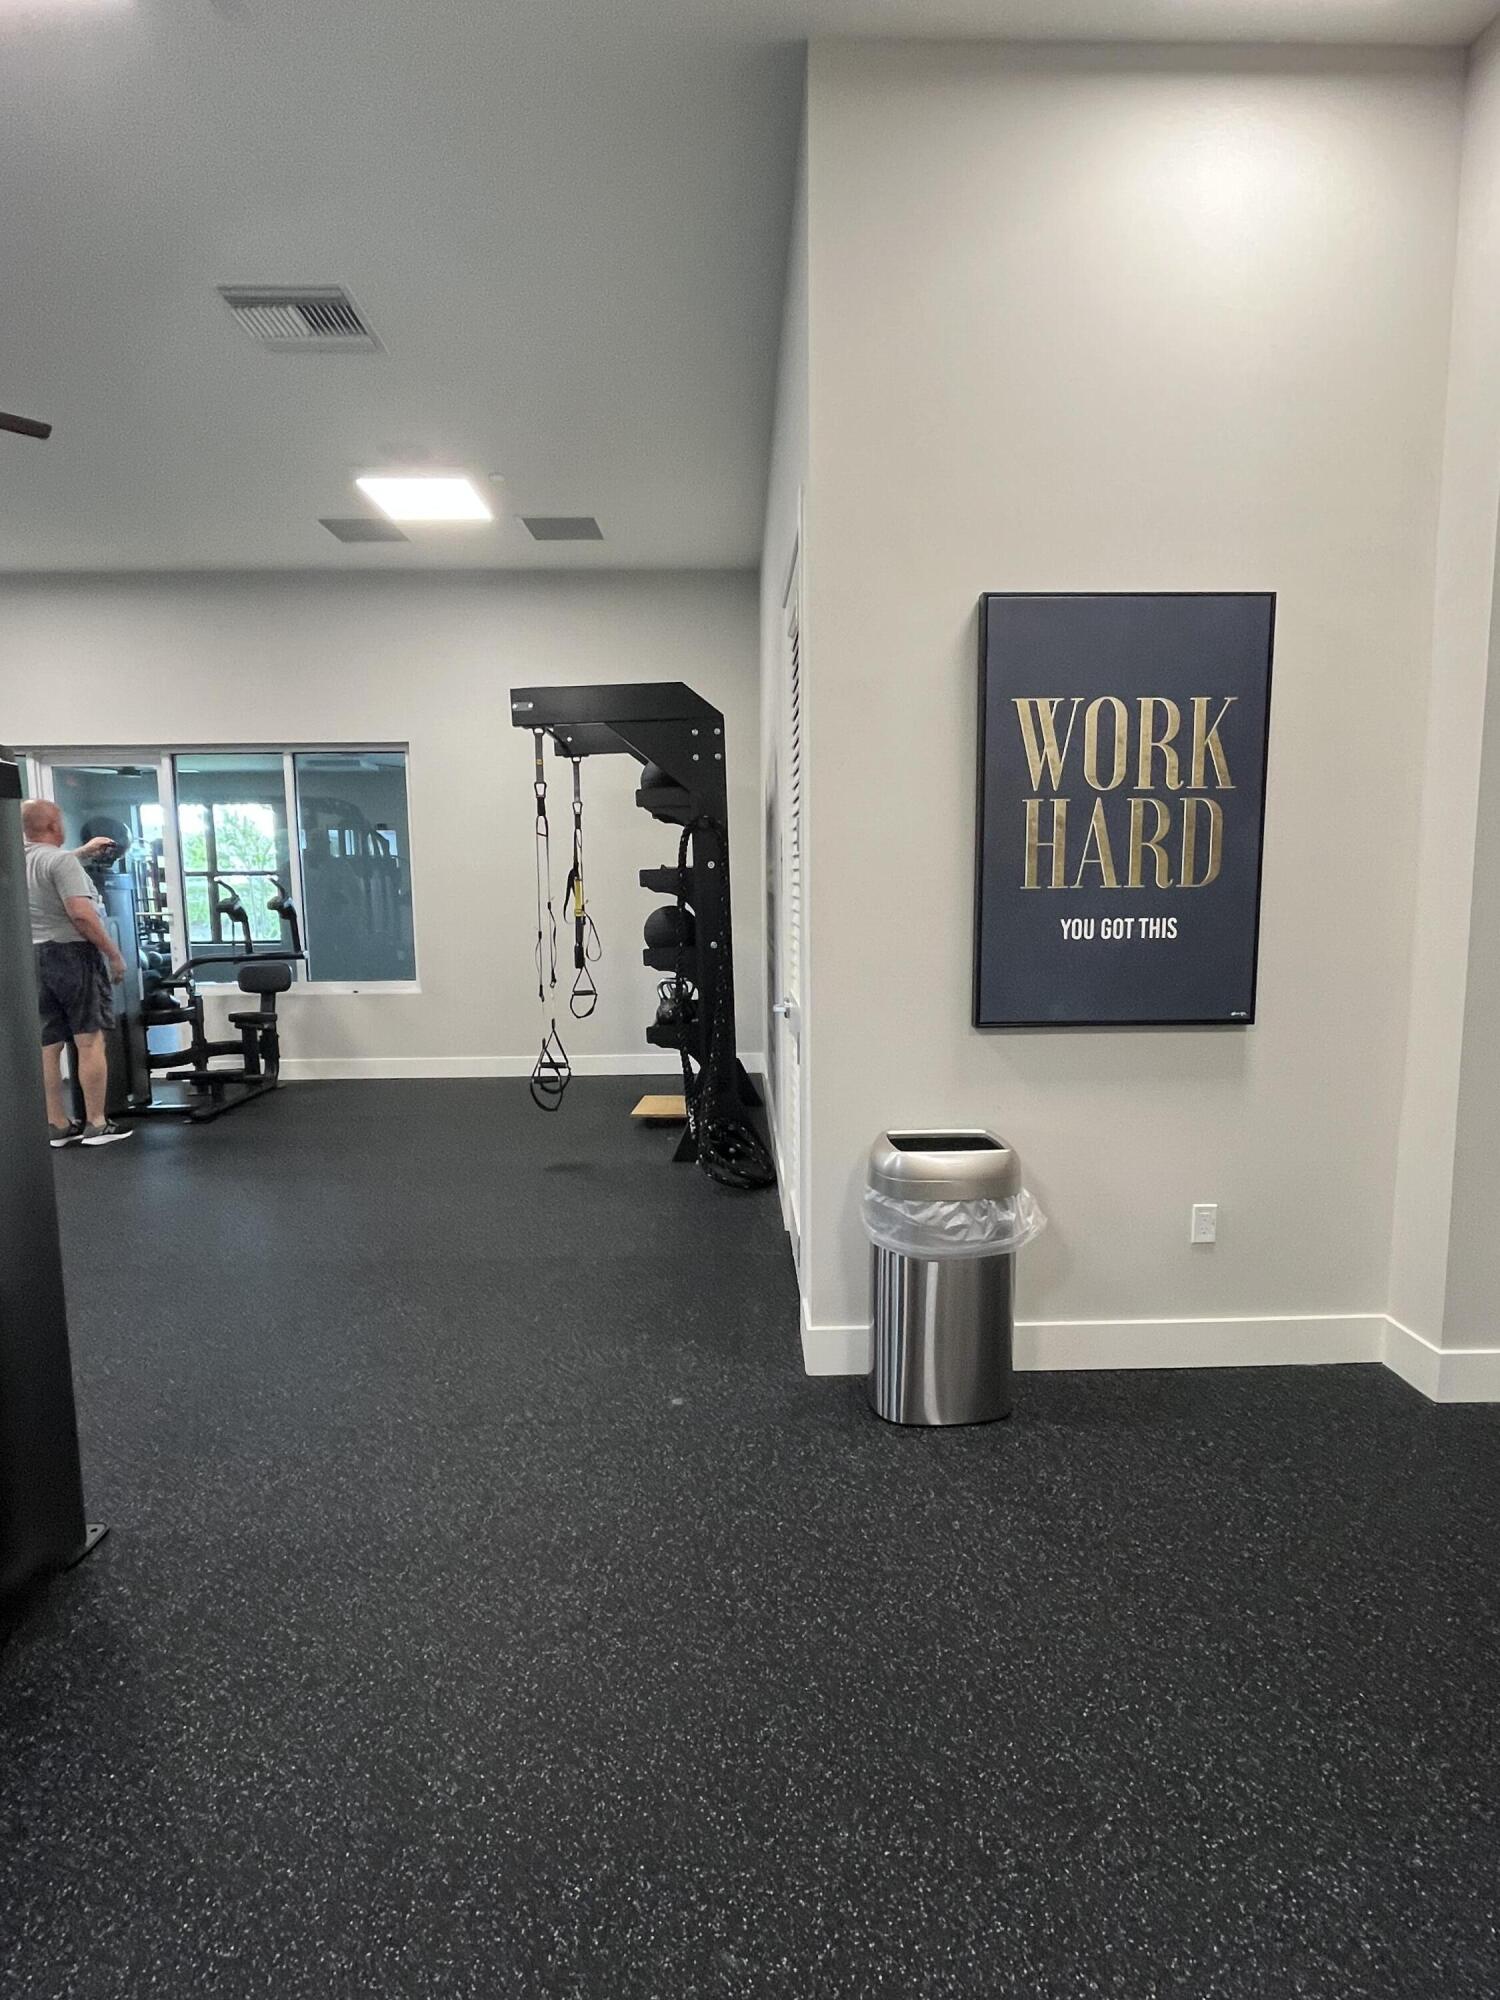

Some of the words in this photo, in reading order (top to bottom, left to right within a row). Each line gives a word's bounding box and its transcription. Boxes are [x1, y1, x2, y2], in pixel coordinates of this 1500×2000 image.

[1012, 696, 1238, 791] WORK
[1020, 797, 1224, 889] HARD
[1060, 918, 1095, 940] YOU
[1100, 918, 1135, 940] GOT
[1138, 917, 1178, 939] THIS
